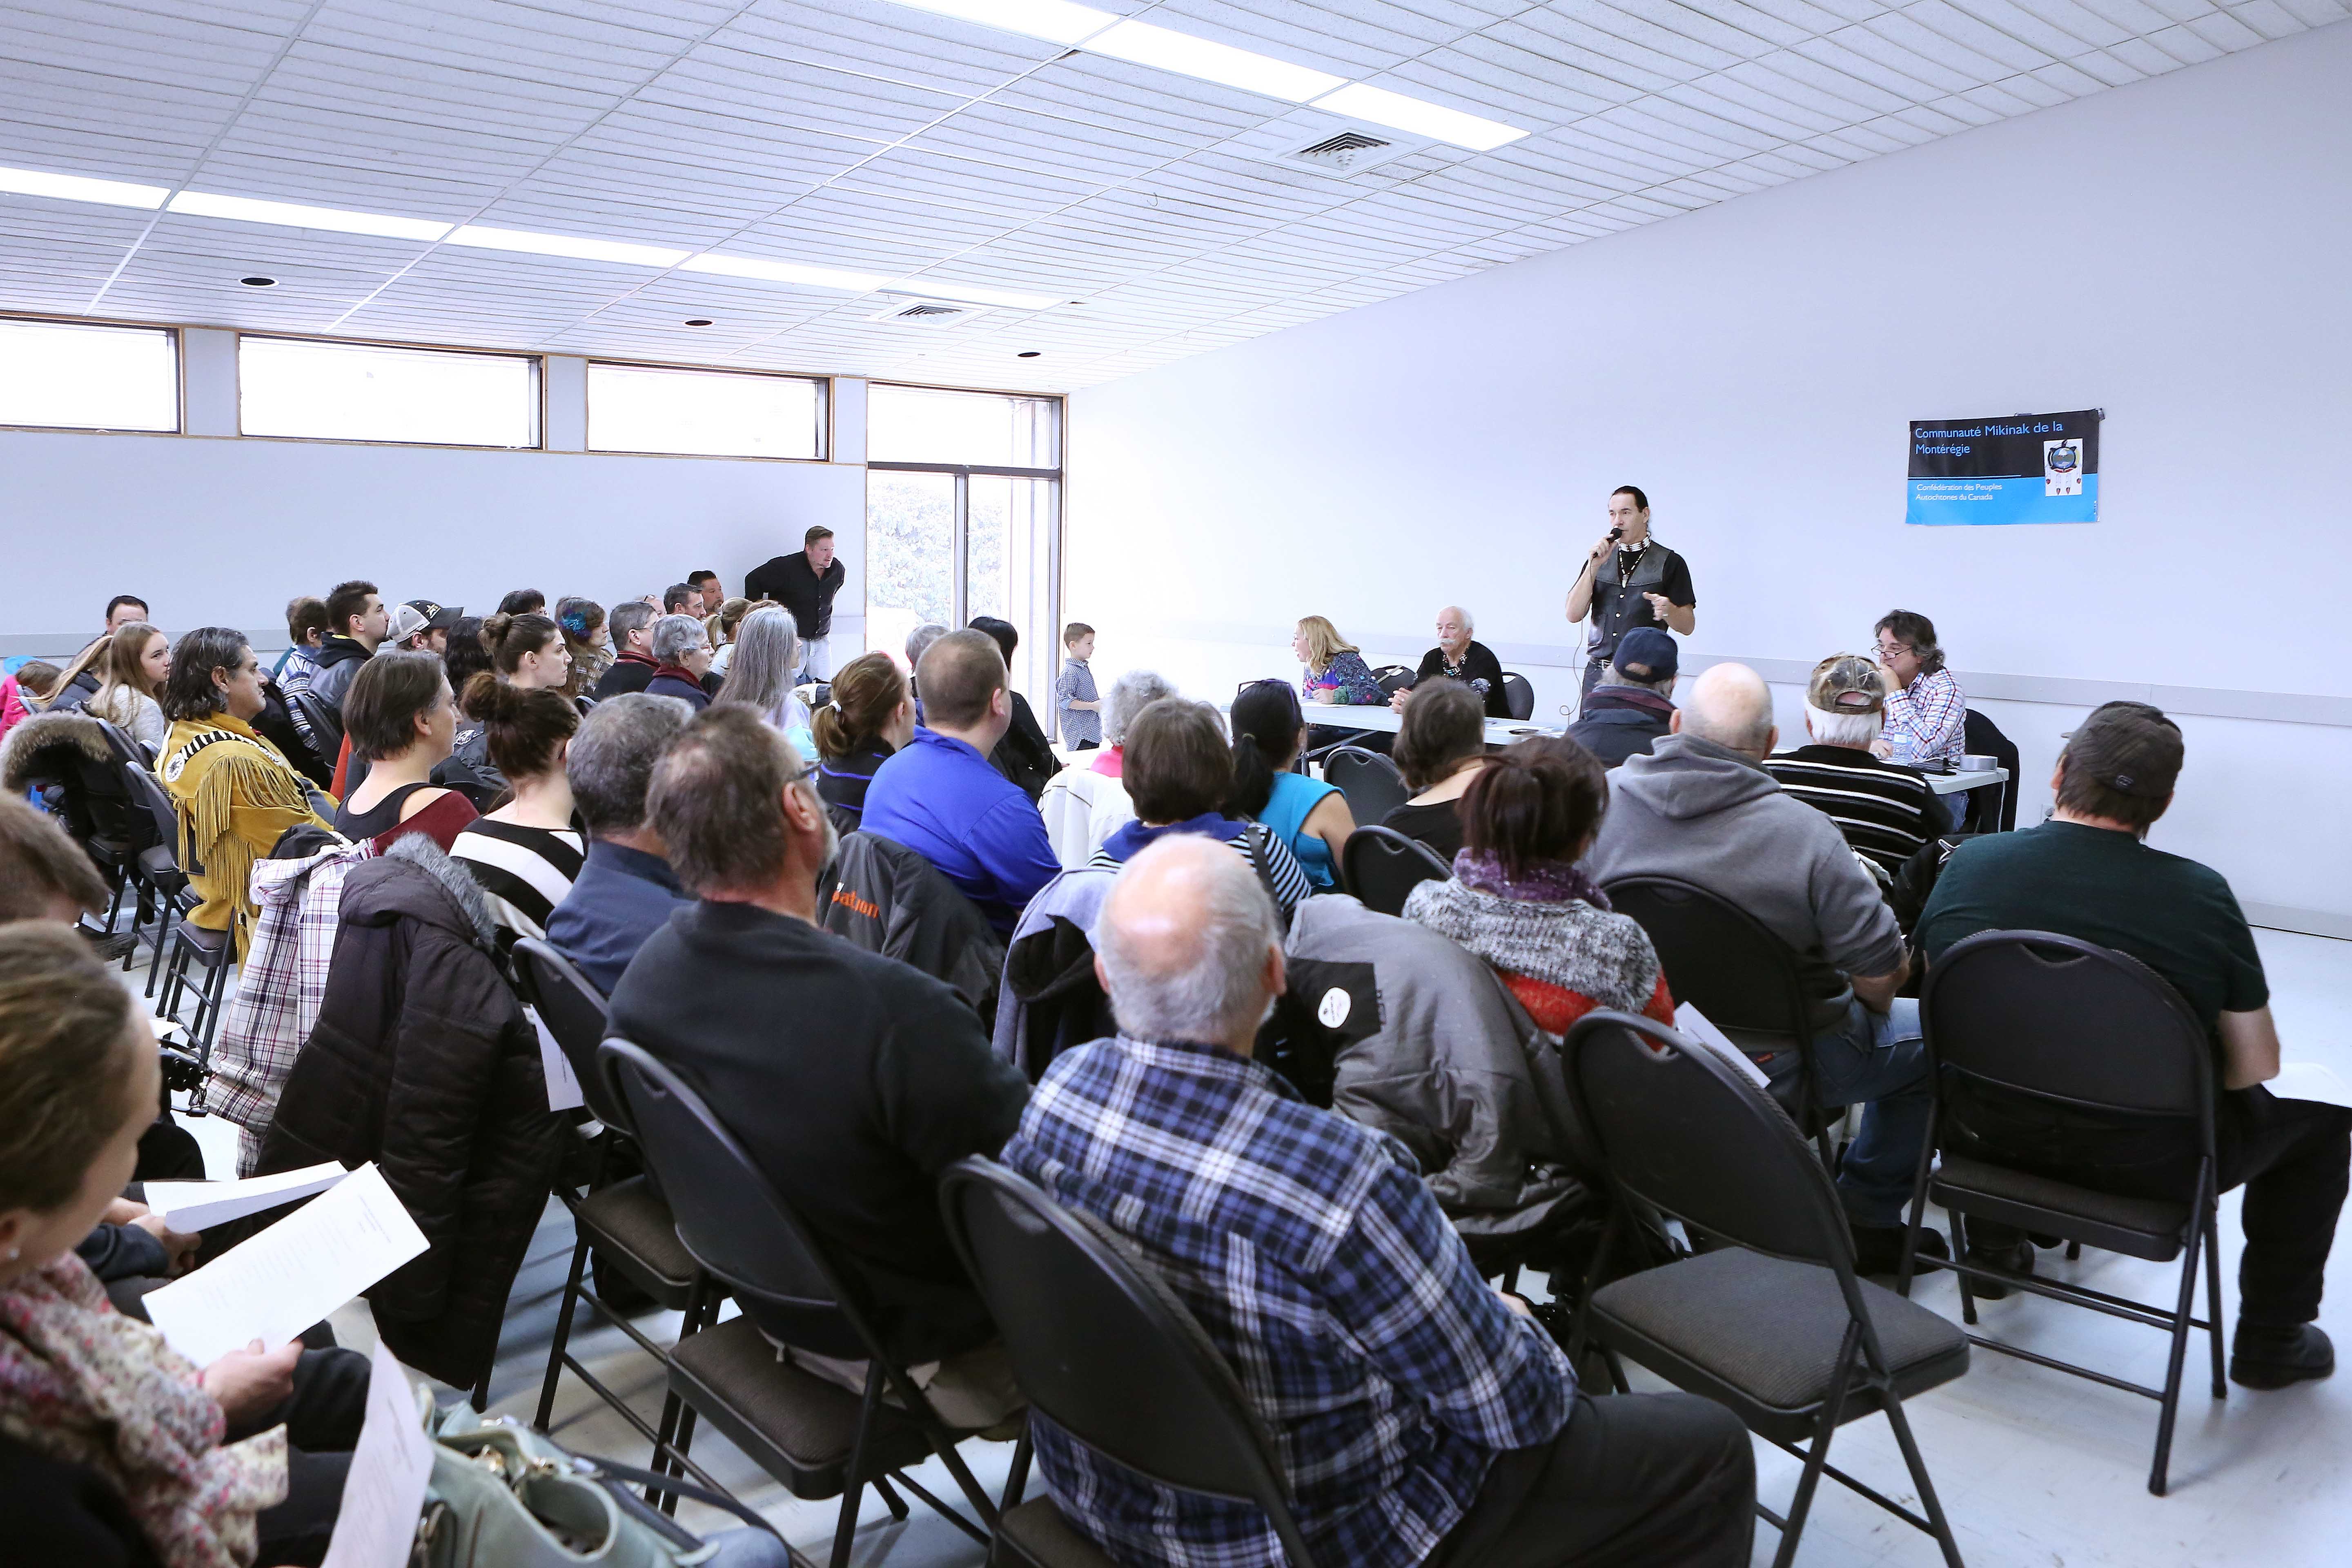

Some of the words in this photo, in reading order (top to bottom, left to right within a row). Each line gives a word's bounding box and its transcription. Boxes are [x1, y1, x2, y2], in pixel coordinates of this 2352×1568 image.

[1915, 426, 1982, 439] Communauté
[1985, 423, 2029, 436] Mikinak
[2034, 423, 2049, 433] de
[2053, 421, 2063, 431] la
[1915, 443, 1970, 457] Montérégie
